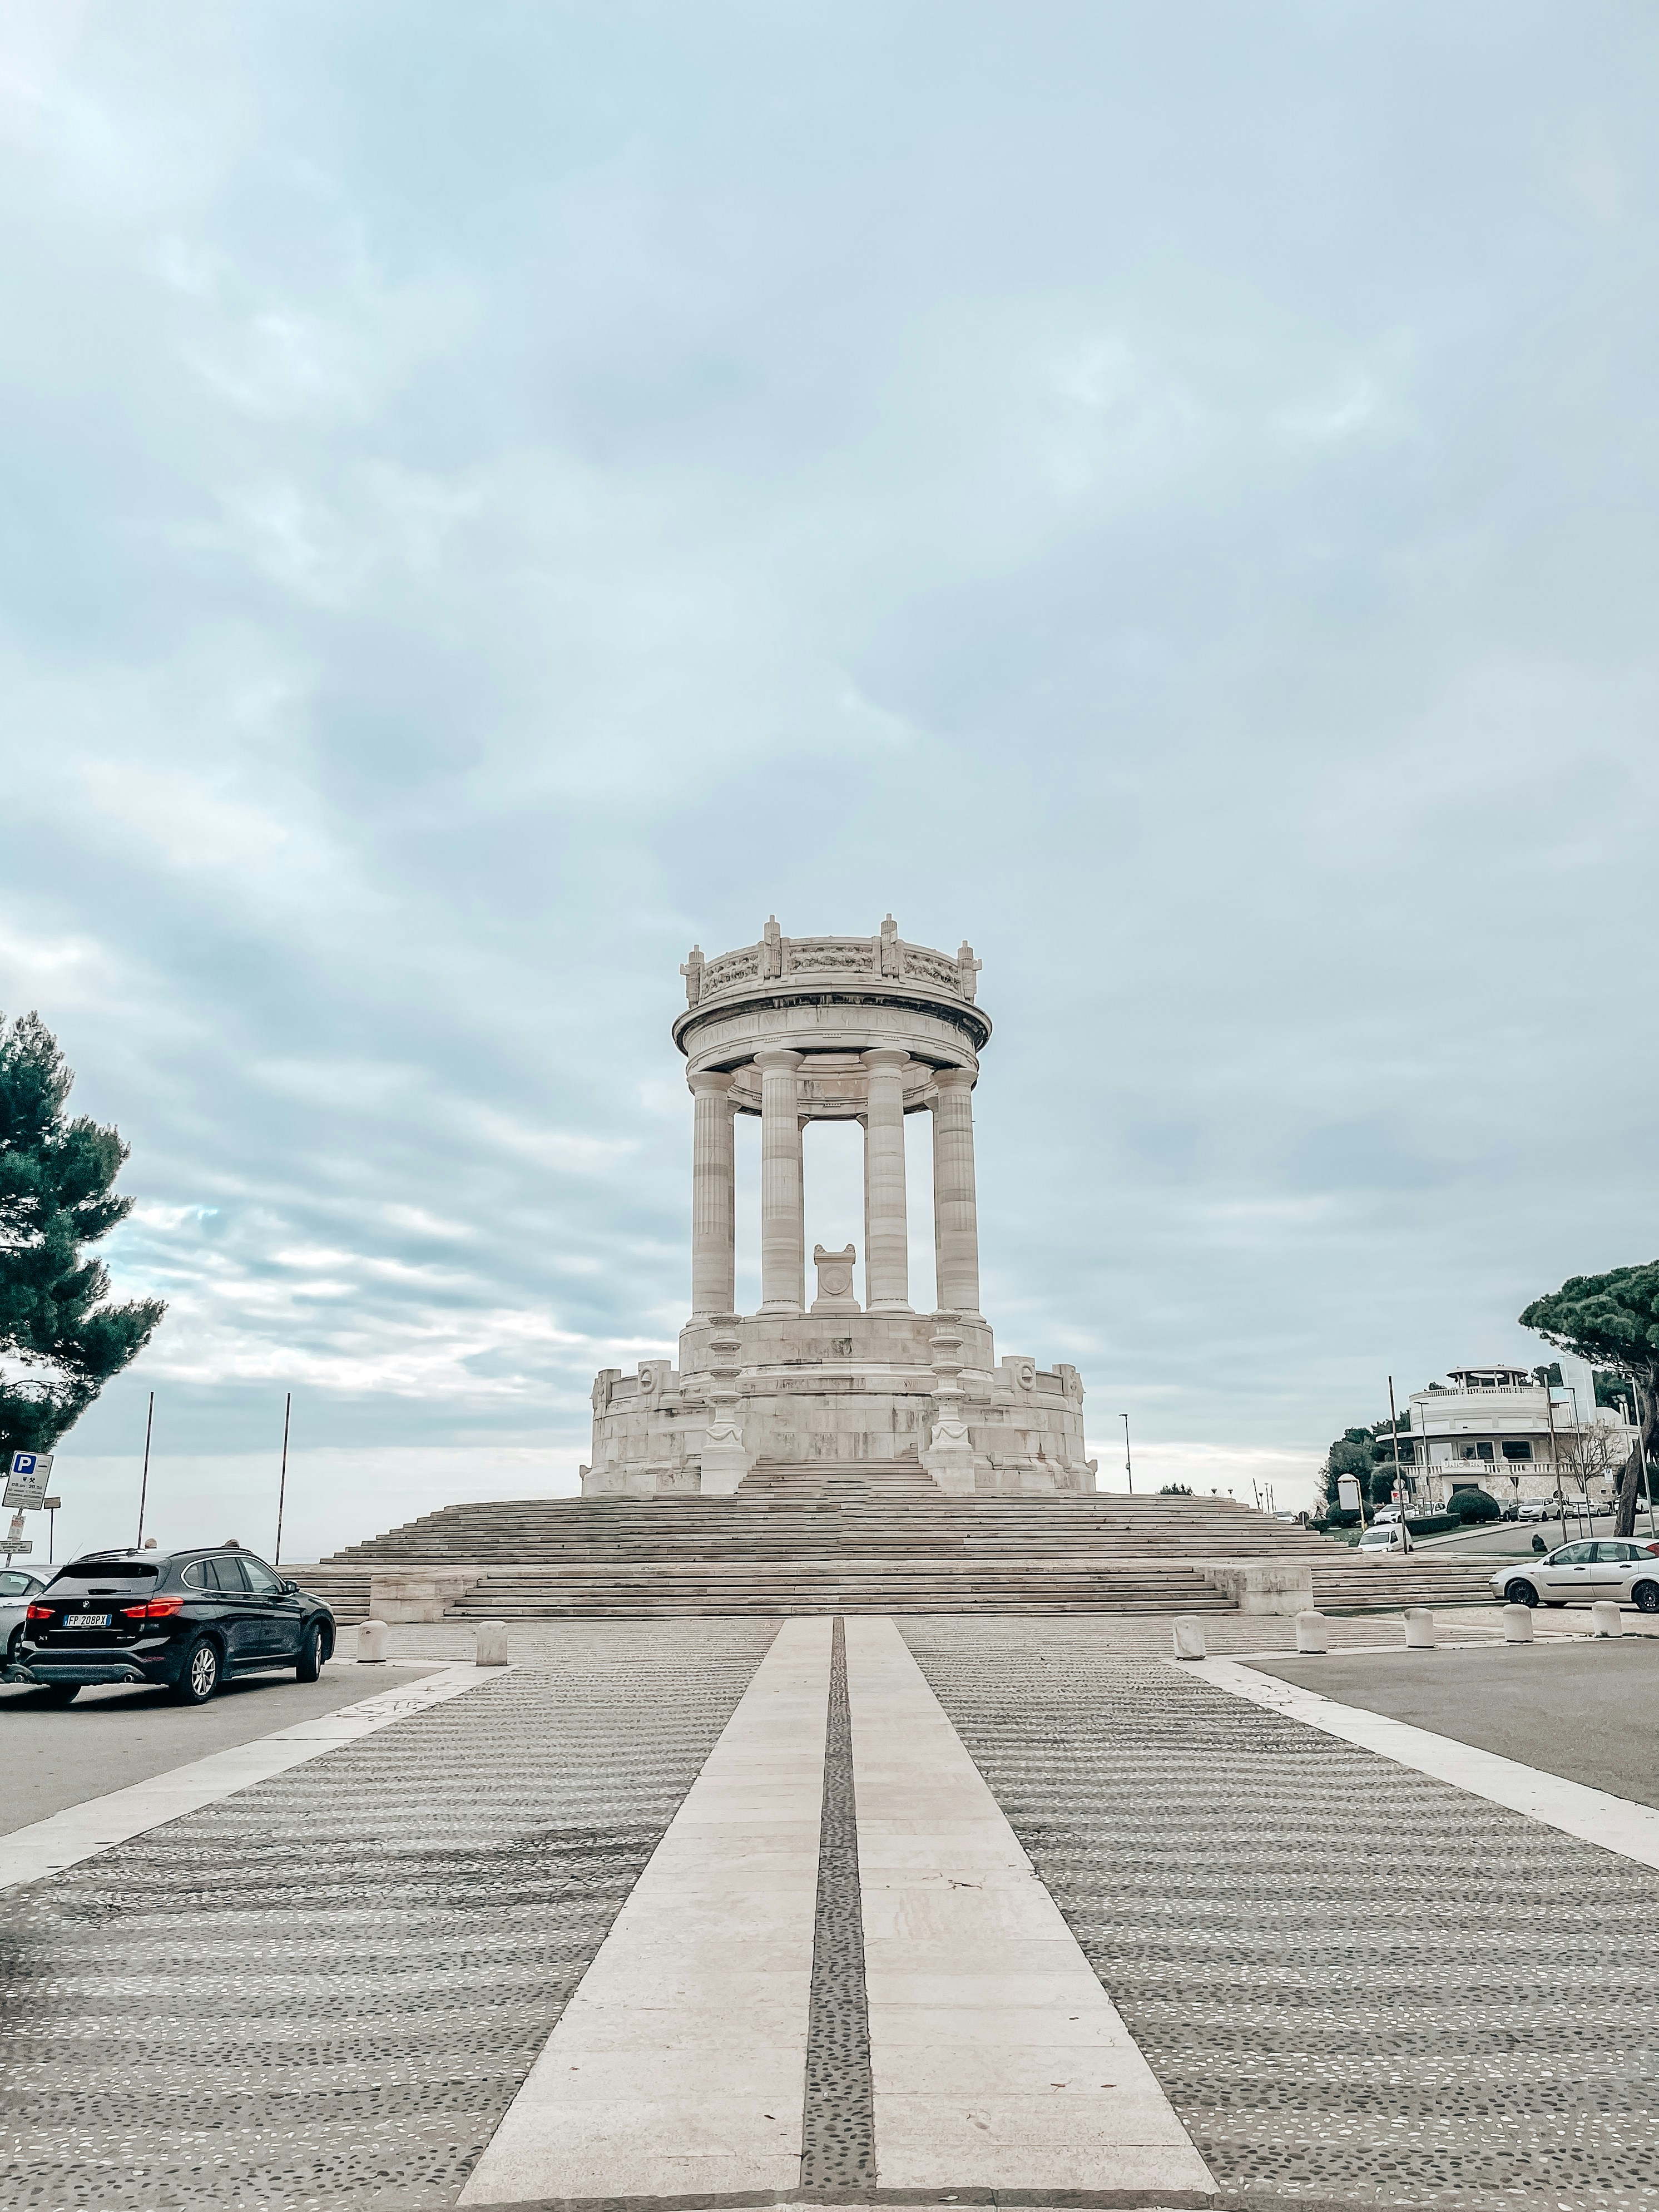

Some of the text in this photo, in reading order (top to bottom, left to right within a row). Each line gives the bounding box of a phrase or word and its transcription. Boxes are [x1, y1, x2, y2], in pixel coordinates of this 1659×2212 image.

[17, 1457, 32, 1471] P
[68, 1616, 79, 1625] FP
[81, 1616, 106, 1625] 208PX
